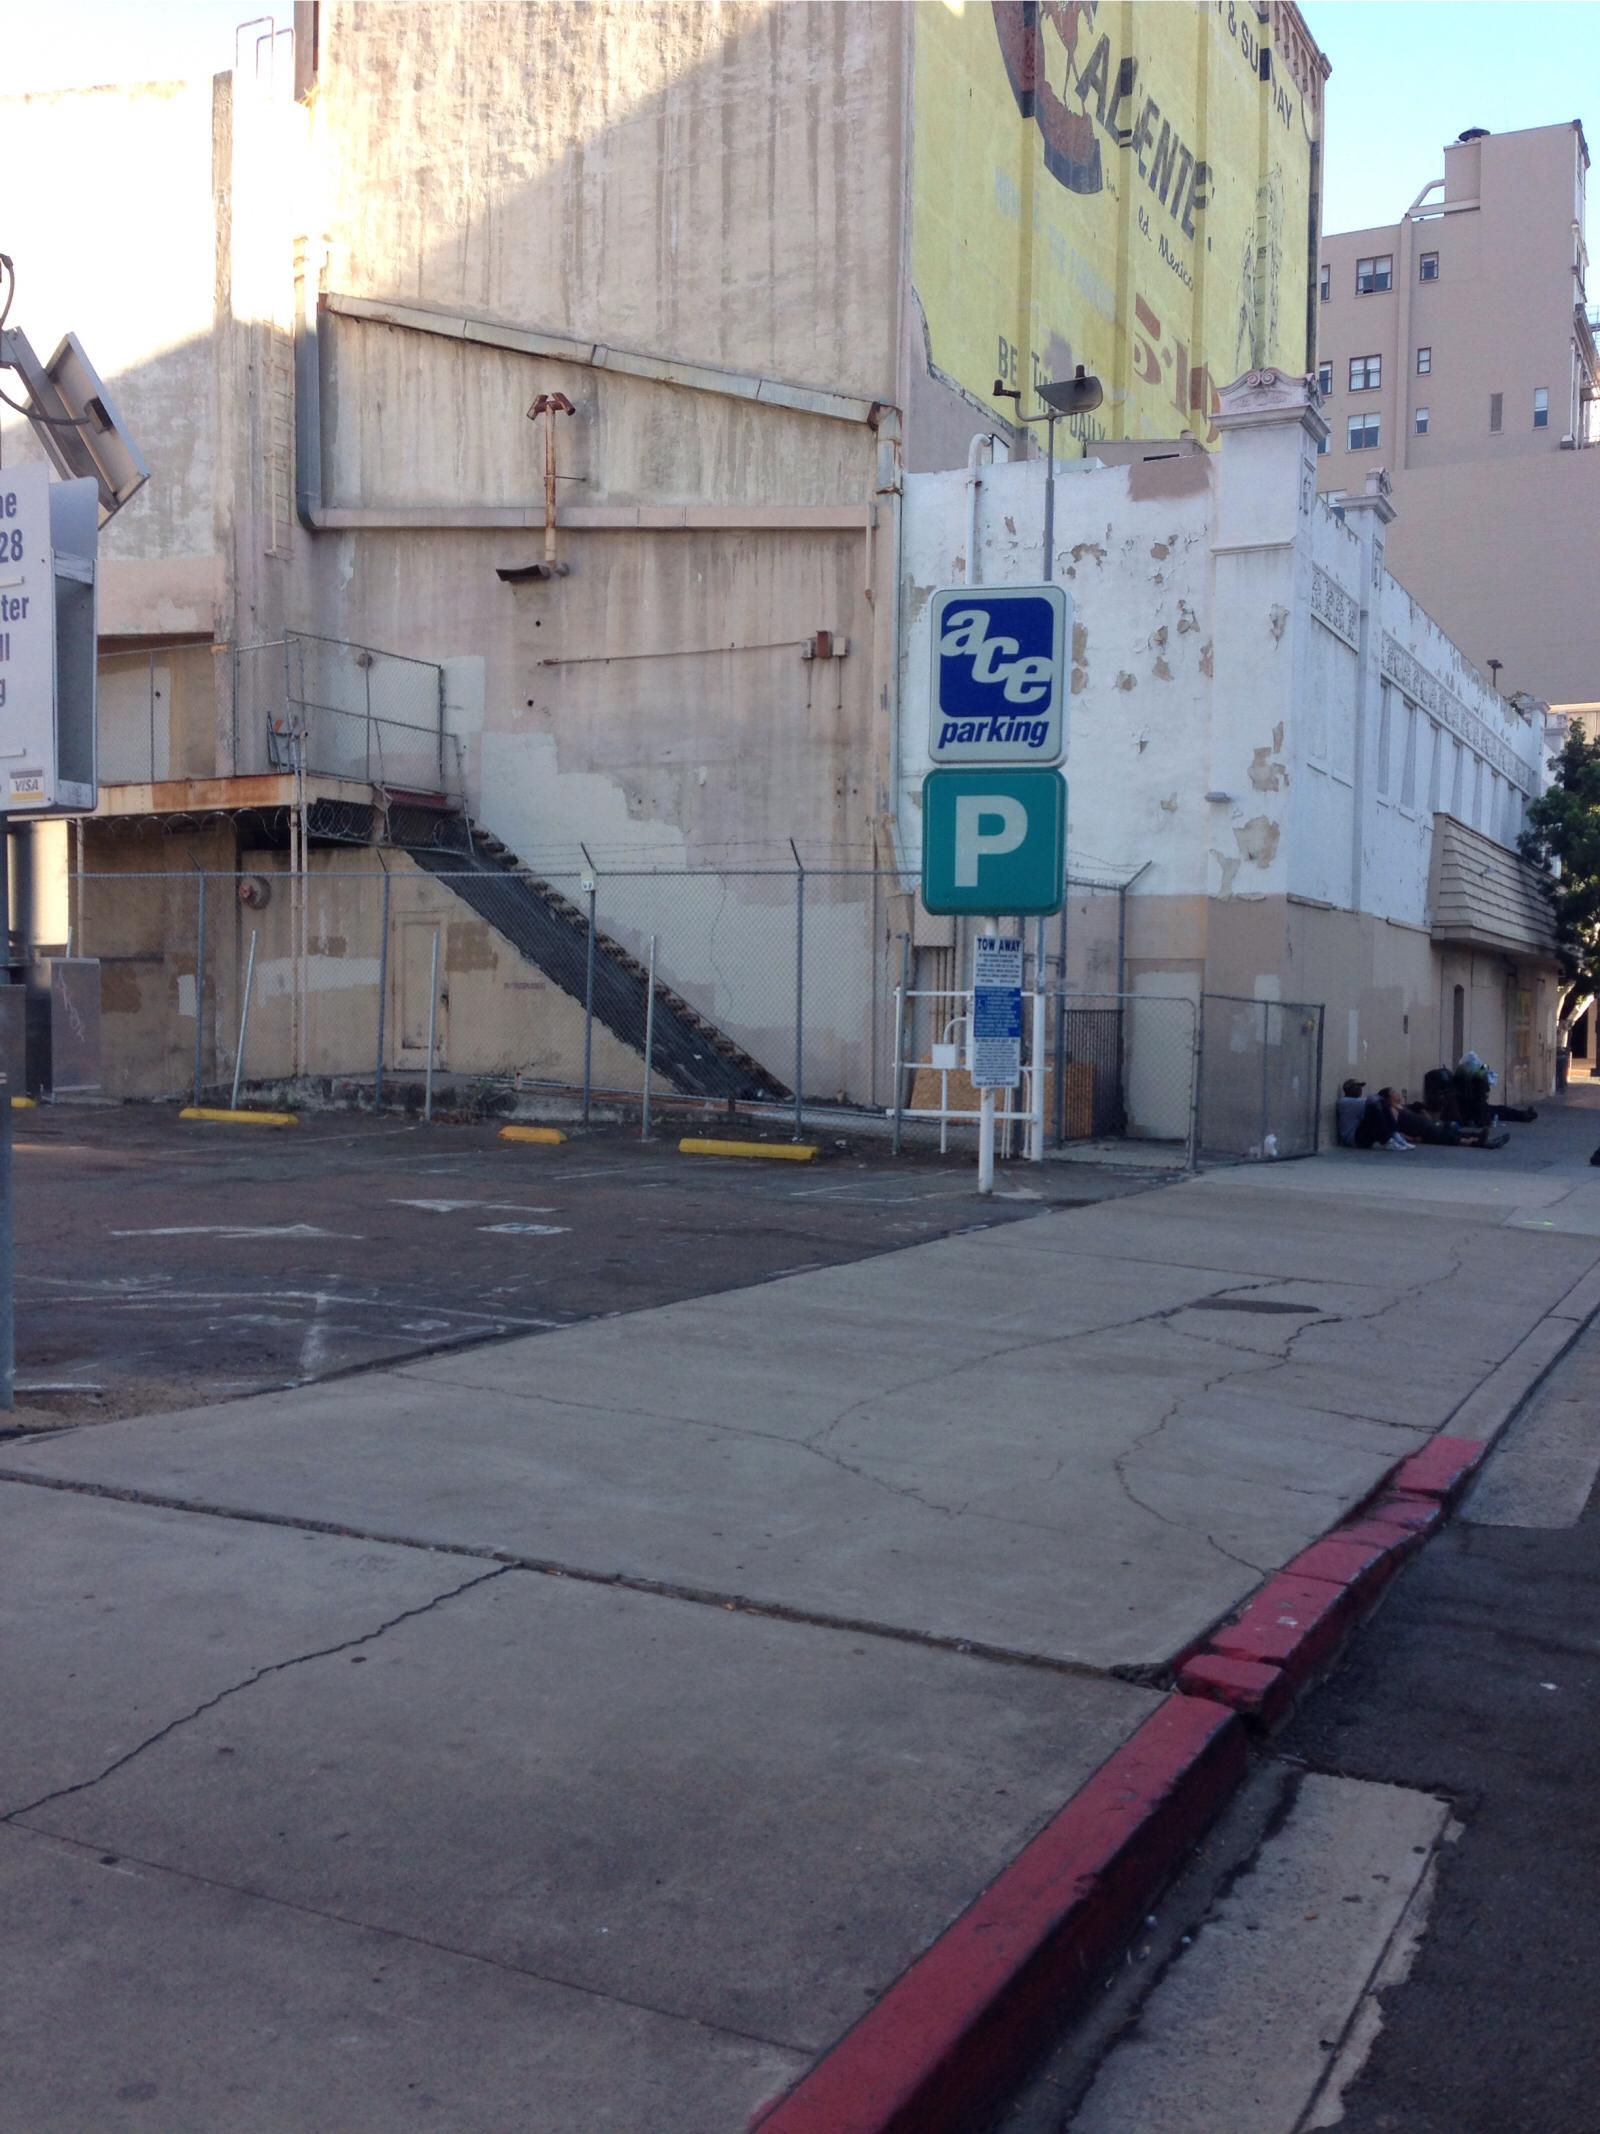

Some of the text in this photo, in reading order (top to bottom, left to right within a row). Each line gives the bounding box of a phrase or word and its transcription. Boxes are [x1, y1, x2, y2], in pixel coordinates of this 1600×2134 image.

[1241, 20, 1292, 131] SUAY
[939, 609, 1053, 704] ace
[938, 716, 1049, 749] parking
[15, 779, 39, 792] VISA
[954, 794, 1028, 888] P
[977, 938, 1020, 952] TOW AWAY
